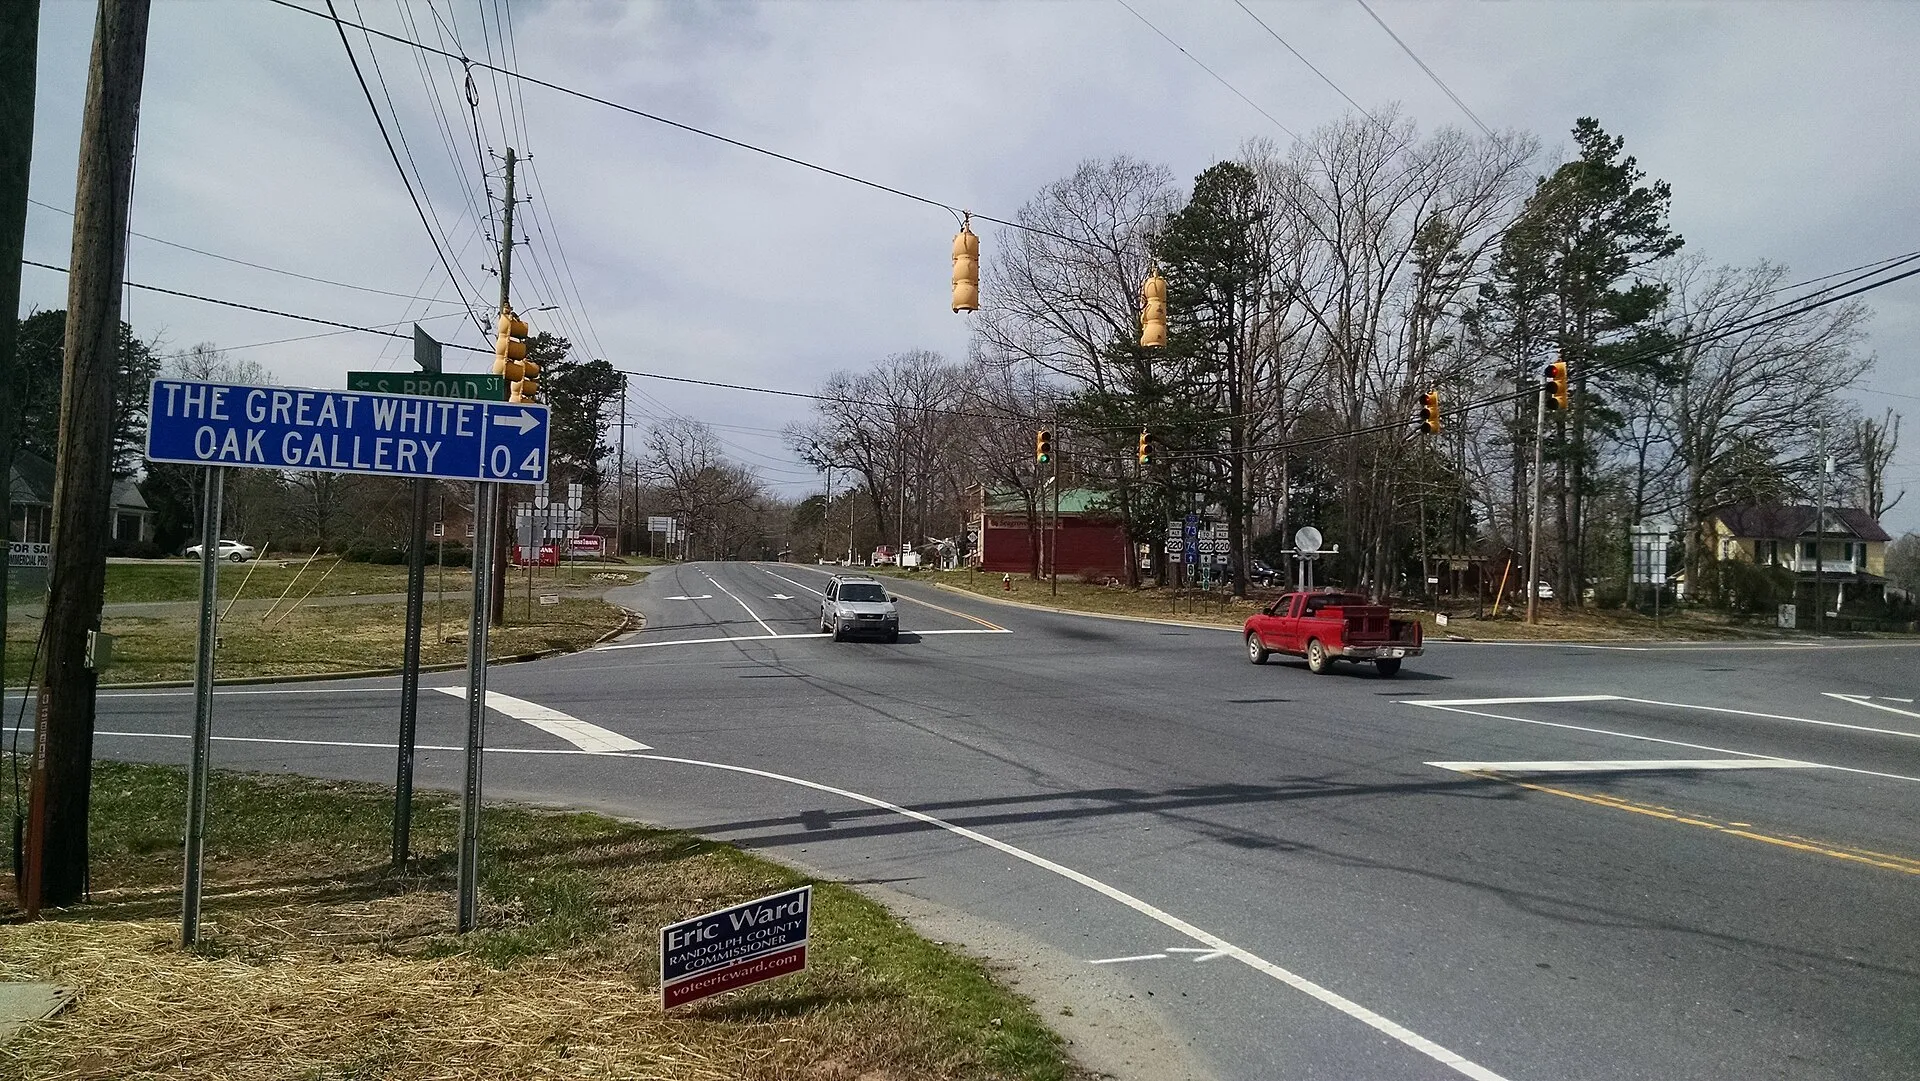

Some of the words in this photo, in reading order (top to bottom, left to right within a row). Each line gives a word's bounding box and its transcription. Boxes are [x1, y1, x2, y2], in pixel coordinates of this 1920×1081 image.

[378, 380, 389, 393] S
[403, 380, 478, 398] BROAD
[486, 377, 500, 391] ST
[163, 383, 230, 421] THE
[246, 389, 360, 428] GREAT
[372, 398, 474, 437] WHITE
[194, 425, 266, 463] OAK
[282, 431, 442, 473] GALLERY
[490, 444, 542, 479] 0.4
[1168, 541, 1182, 549] 220
[1187, 526, 1197, 535] 73
[1187, 541, 1196, 550] 74
[1216, 543, 1229, 551] 220
[9, 544, 29, 553] FOR
[668, 922, 719, 952] Eric
[728, 892, 805, 931] Ward
[669, 935, 743, 966] RANDOLPH
[746, 919, 802, 942] COUNTY
[685, 935, 787, 971] COMMISSIONER
[673, 953, 798, 998] voteericward.com
